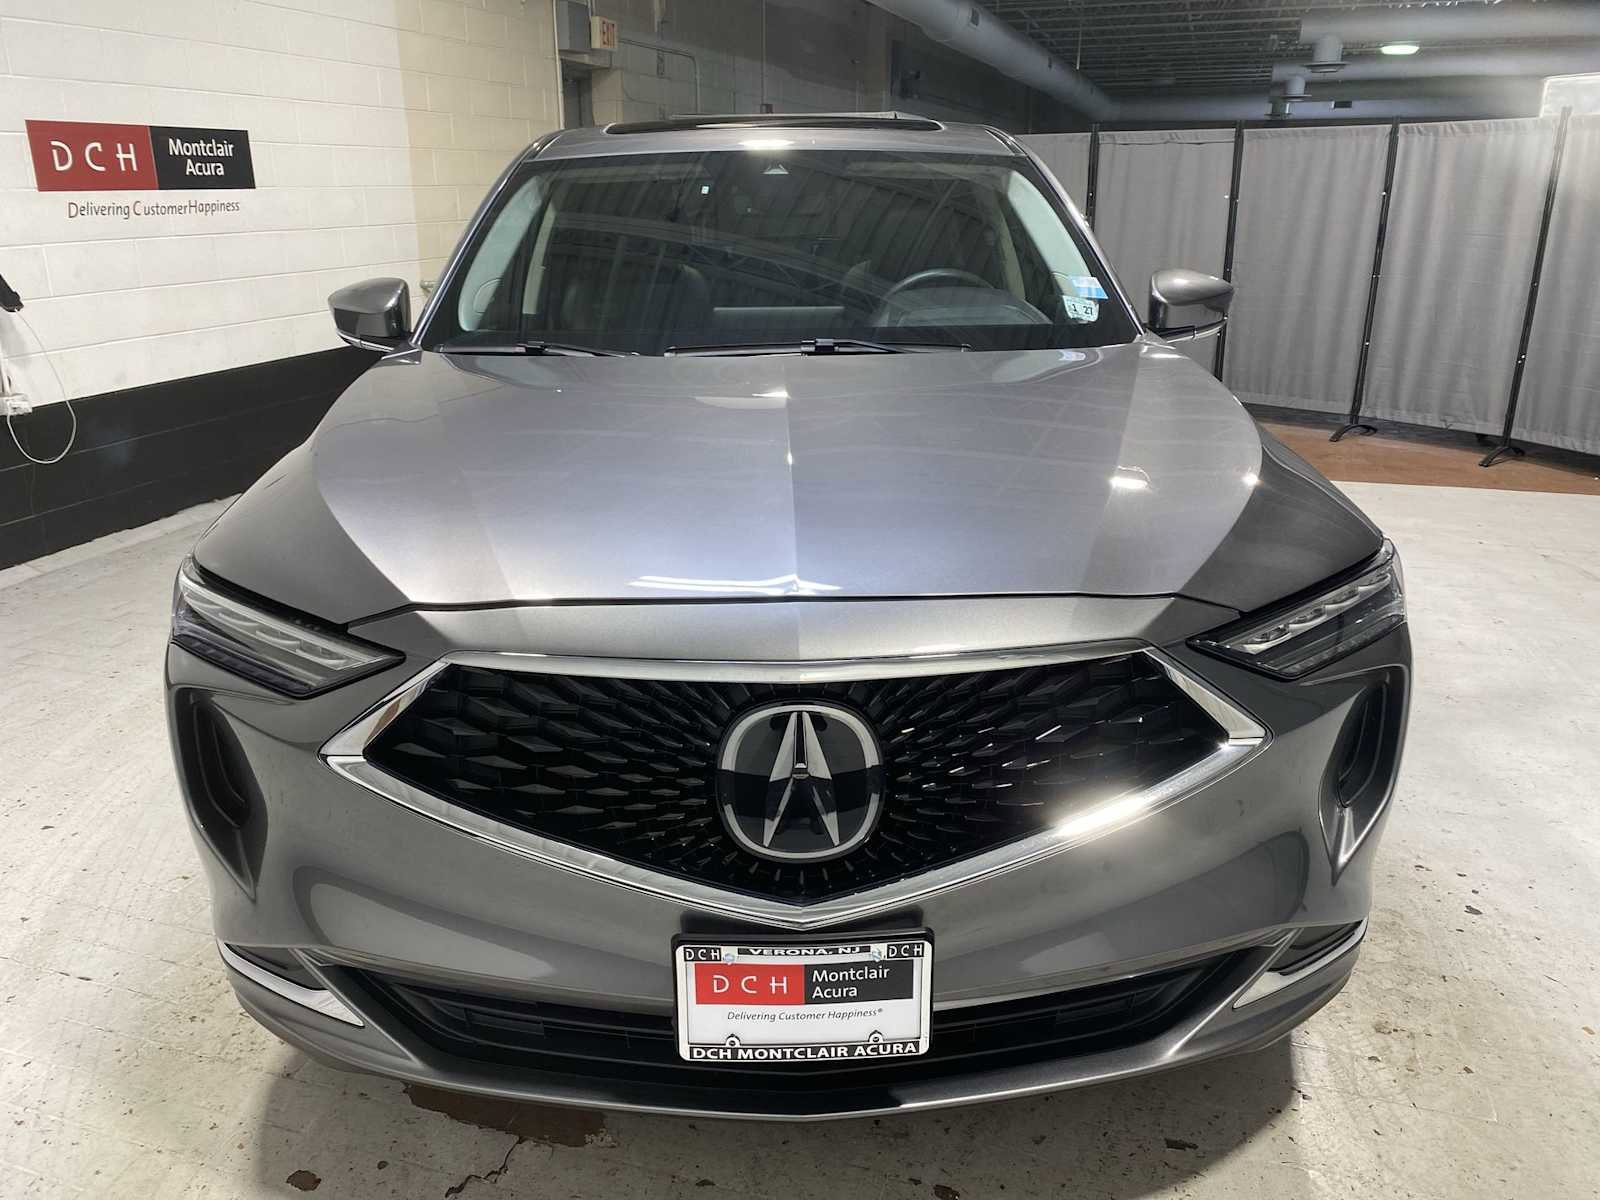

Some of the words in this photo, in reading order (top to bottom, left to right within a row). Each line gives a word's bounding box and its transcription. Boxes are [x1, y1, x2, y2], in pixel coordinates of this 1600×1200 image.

[168, 138, 235, 157] Montclair
[185, 159, 225, 176] Acura
[68, 202, 130, 219] Delivering
[686, 948, 721, 960] DCH
[838, 946, 860, 954] NJ
[888, 944, 923, 958] DCH
[812, 965, 890, 983] Montclair
[812, 986, 858, 999] Acura
[727, 1011, 776, 1022] Delivering
[778, 1011, 825, 1020] Customer
[693, 1048, 732, 1060] DCH
[737, 1046, 849, 1060] MONTCLAIR
[854, 1042, 917, 1056] ACURA
